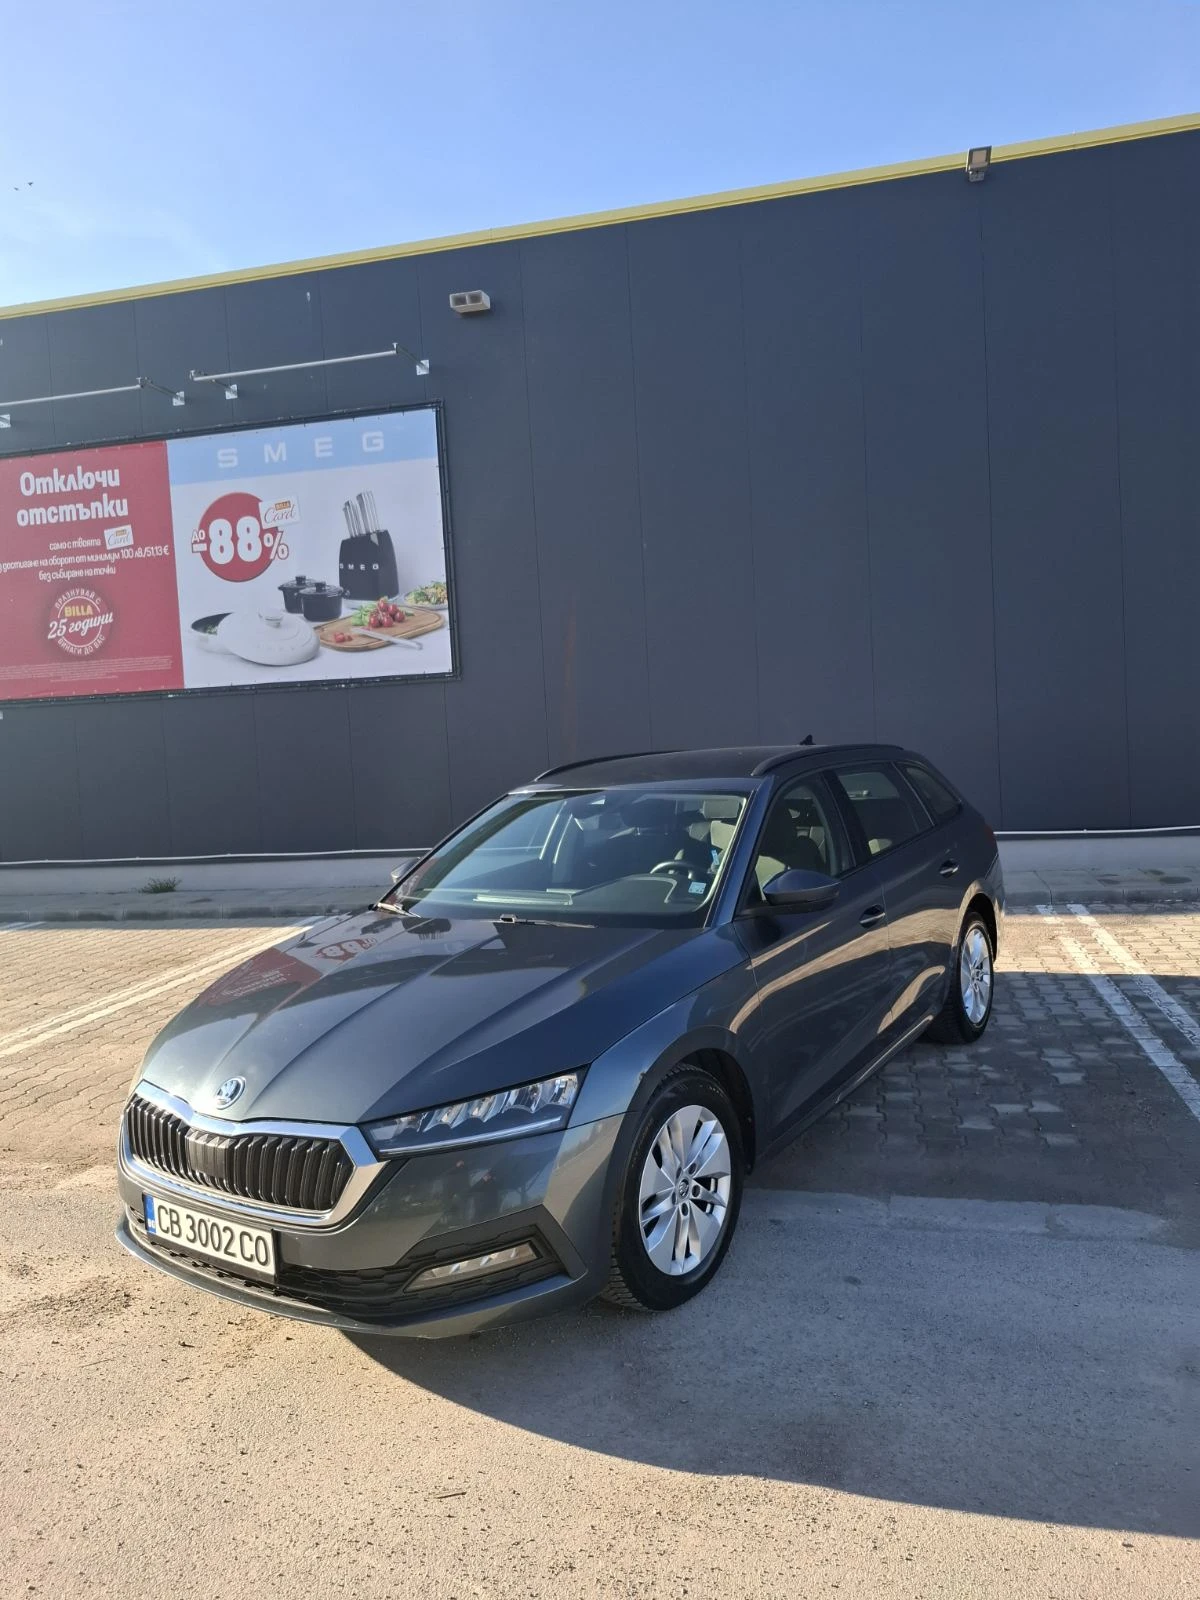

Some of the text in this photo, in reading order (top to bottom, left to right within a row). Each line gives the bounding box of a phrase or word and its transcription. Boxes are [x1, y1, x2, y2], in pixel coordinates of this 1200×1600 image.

[217, 431, 384, 468] SMEG
[20, 465, 120, 496] Отключи
[16, 493, 129, 526] отстъпки
[72, 536, 101, 548] твоята
[49, 555, 75, 567] оборот
[120, 548, 134, 559] 100
[47, 612, 113, 639] 25 години
[64, 605, 93, 617] BILLA
[157, 1204, 182, 1238] CB
[185, 1214, 237, 1258] 3002
